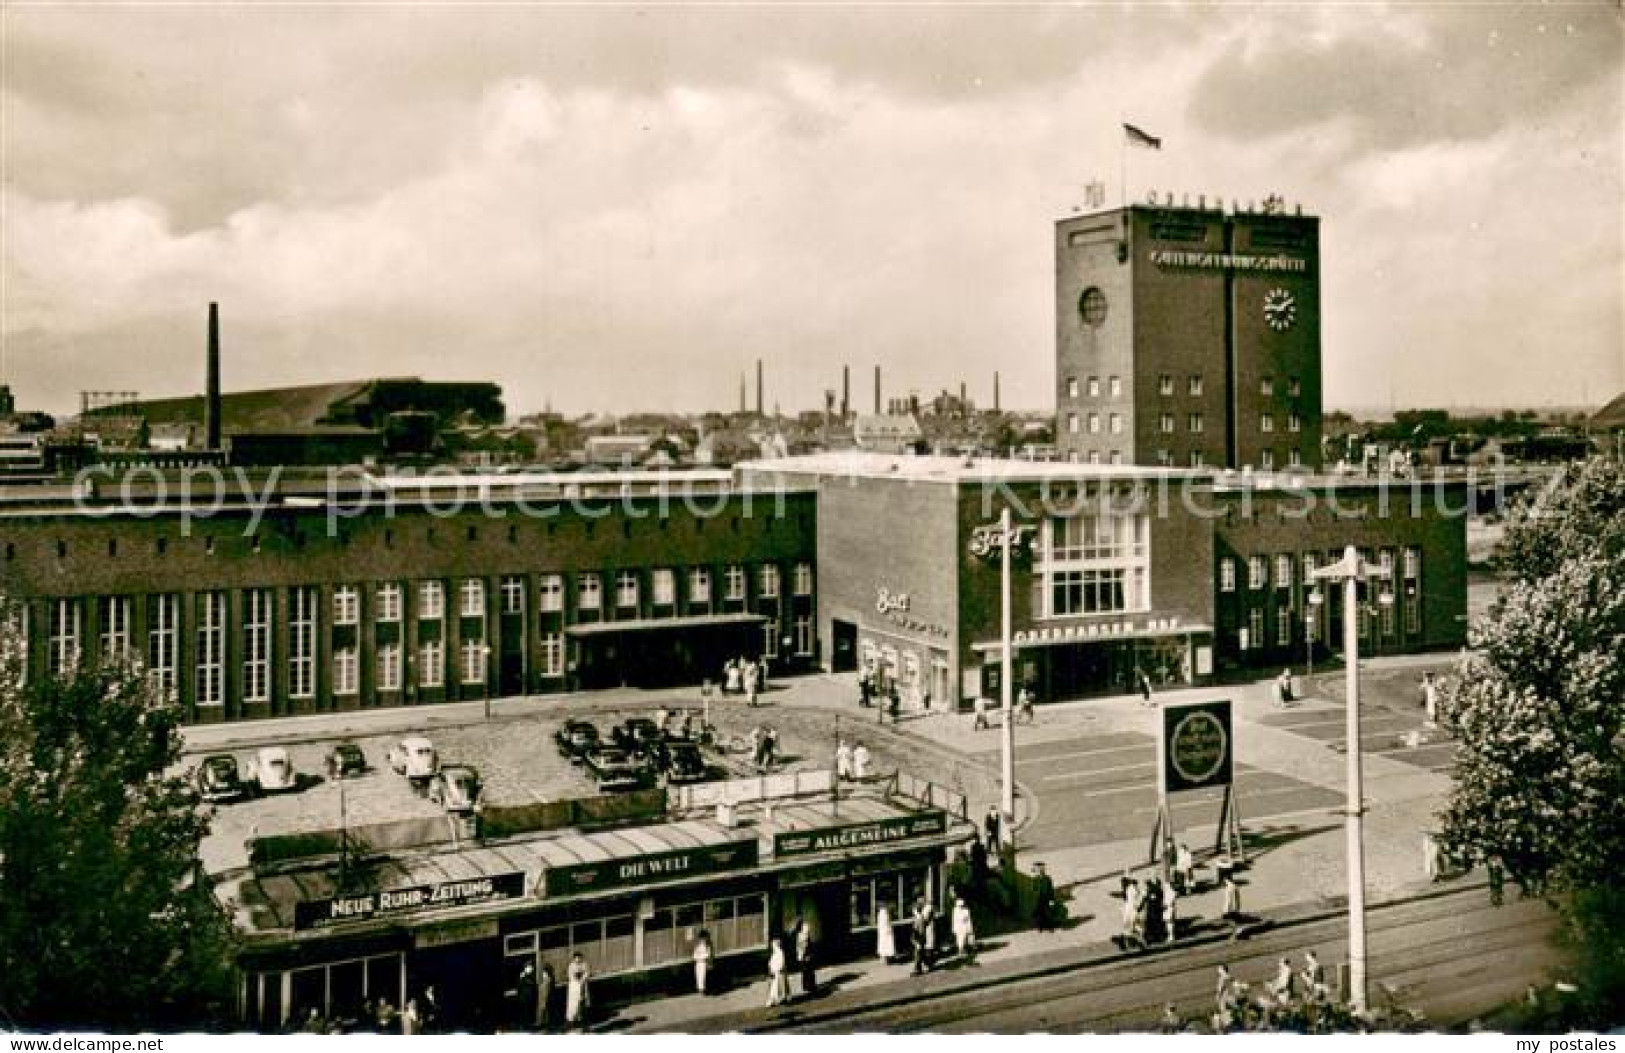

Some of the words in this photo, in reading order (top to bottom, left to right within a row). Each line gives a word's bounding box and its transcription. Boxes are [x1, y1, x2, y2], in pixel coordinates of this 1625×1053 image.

[815, 825, 907, 848] ALLGEMEINE
[620, 861, 645, 878] DIE
[649, 855, 688, 873] WELT
[331, 895, 374, 918] NEUE
